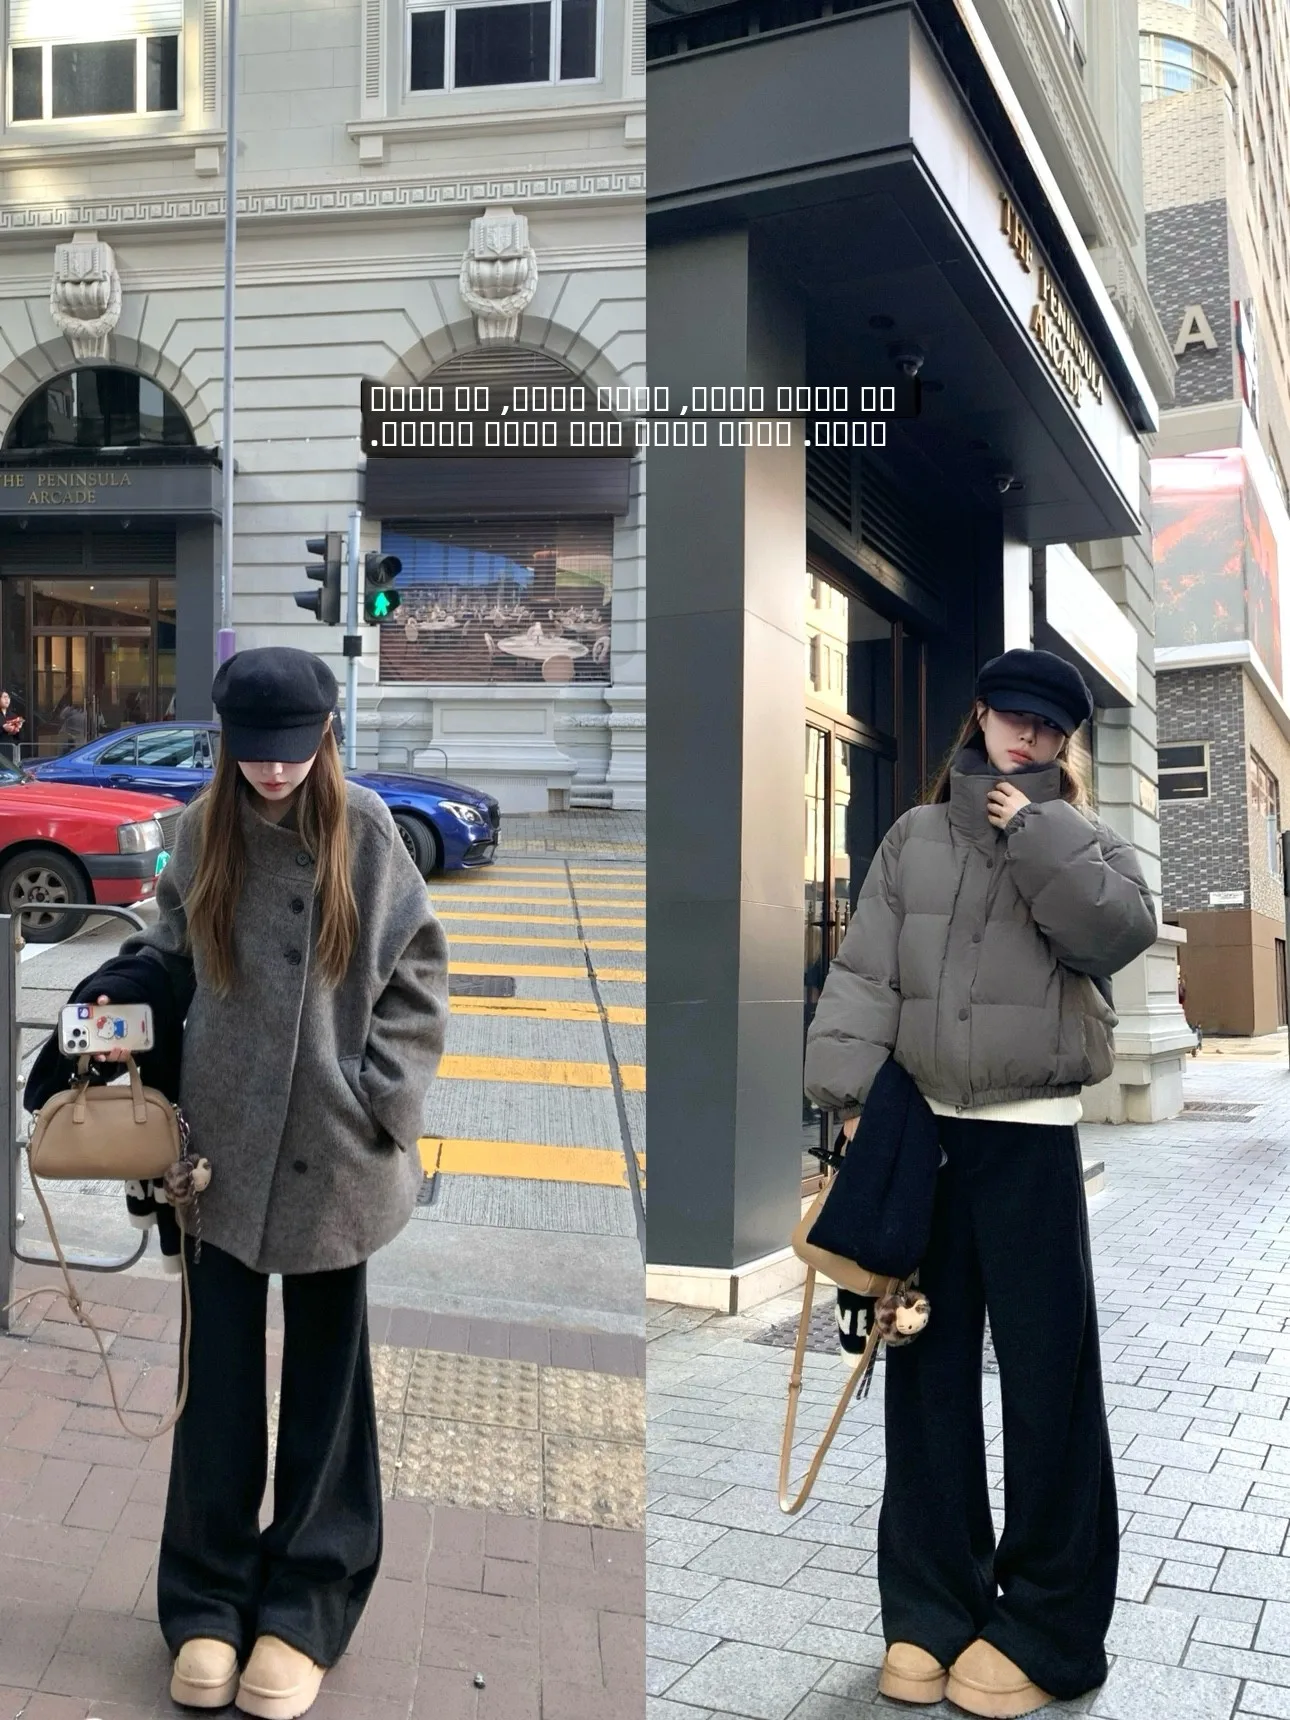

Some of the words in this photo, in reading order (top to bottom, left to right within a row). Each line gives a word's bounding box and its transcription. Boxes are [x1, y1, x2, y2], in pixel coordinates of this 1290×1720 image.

[999, 191, 1033, 273] THE
[1038, 266, 1104, 405] PENINSULA
[1029, 304, 1082, 408] ARCADE
[1173, 304, 1219, 356] A
[0, 474, 25, 487] HE
[37, 472, 132, 487] PENINSULA
[27, 490, 96, 504] ARCADE
